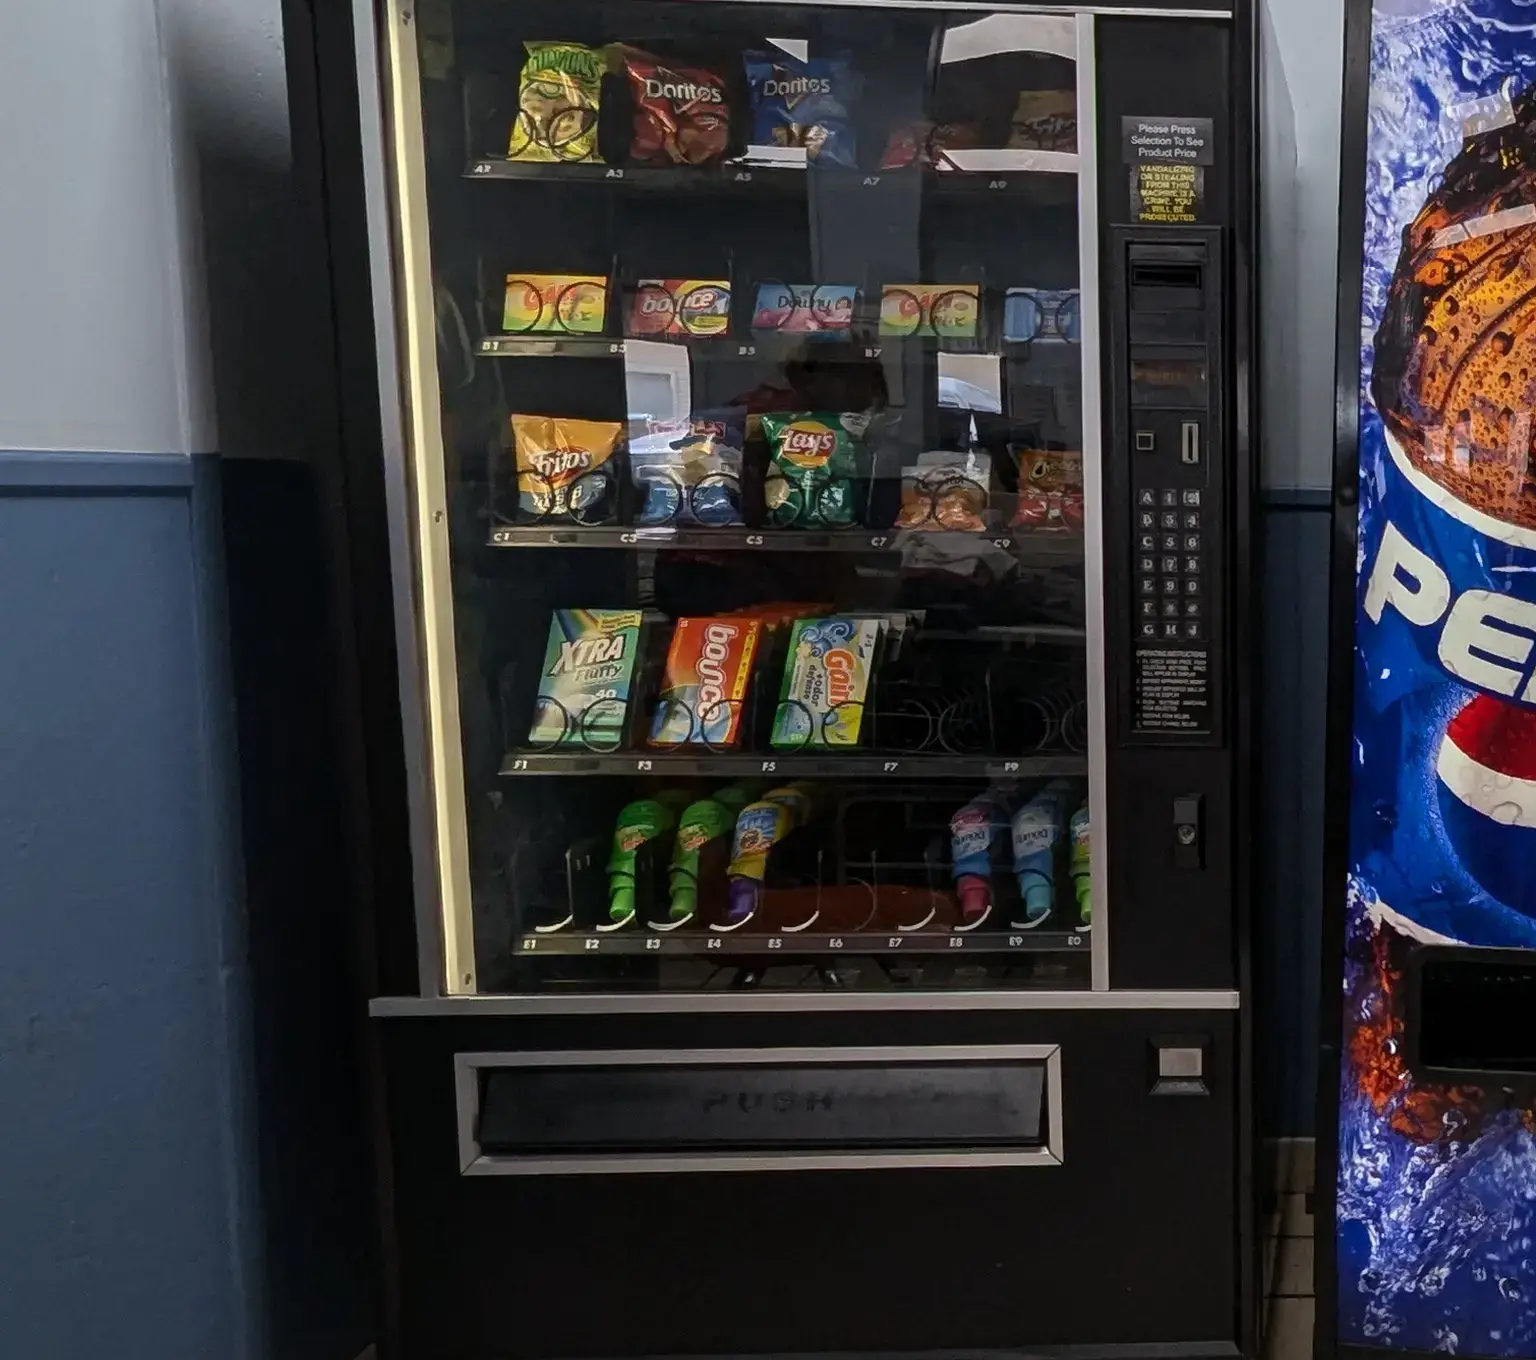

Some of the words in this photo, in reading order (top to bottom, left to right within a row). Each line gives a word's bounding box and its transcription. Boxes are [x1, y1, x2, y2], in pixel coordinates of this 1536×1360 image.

[646, 78, 722, 104] Doritos
[763, 76, 830, 97] Doritos
[1138, 124, 1168, 133] Please
[1171, 125, 1196, 134] Press
[1130, 136, 1171, 145] Selection
[1174, 136, 1183, 145] To
[1186, 137, 1204, 146] See
[1138, 148, 1172, 157] Product
[1174, 148, 1197, 158] Price
[606, 169, 623, 178] A3
[863, 177, 880, 185] A7
[482, 342, 499, 351] B1
[610, 343, 626, 353] B3
[864, 349, 882, 358] B7
[784, 428, 832, 453] Lay's
[533, 450, 592, 477] Fritos
[493, 533, 511, 542] C1
[620, 534, 637, 543] C3
[746, 535, 763, 544] C5
[871, 537, 887, 546] C7
[551, 634, 624, 676] XTRA
[575, 663, 622, 683] Fluffy
[697, 625, 736, 721] bounce
[595, 689, 616, 699] 40
[513, 760, 528, 770] F1
[638, 760, 652, 770] F3
[762, 762, 776, 771] F5
[884, 762, 899, 771] F7
[1005, 762, 1019, 771] F9
[585, 939, 600, 949] E2
[646, 939, 660, 949] E3
[707, 939, 722, 948] E4
[768, 939, 782, 948] E5
[829, 939, 843, 948] E6
[889, 938, 902, 947] E7
[950, 938, 963, 947] E8
[1009, 937, 1023, 946] E9
[702, 1089, 833, 1113] PUSH
